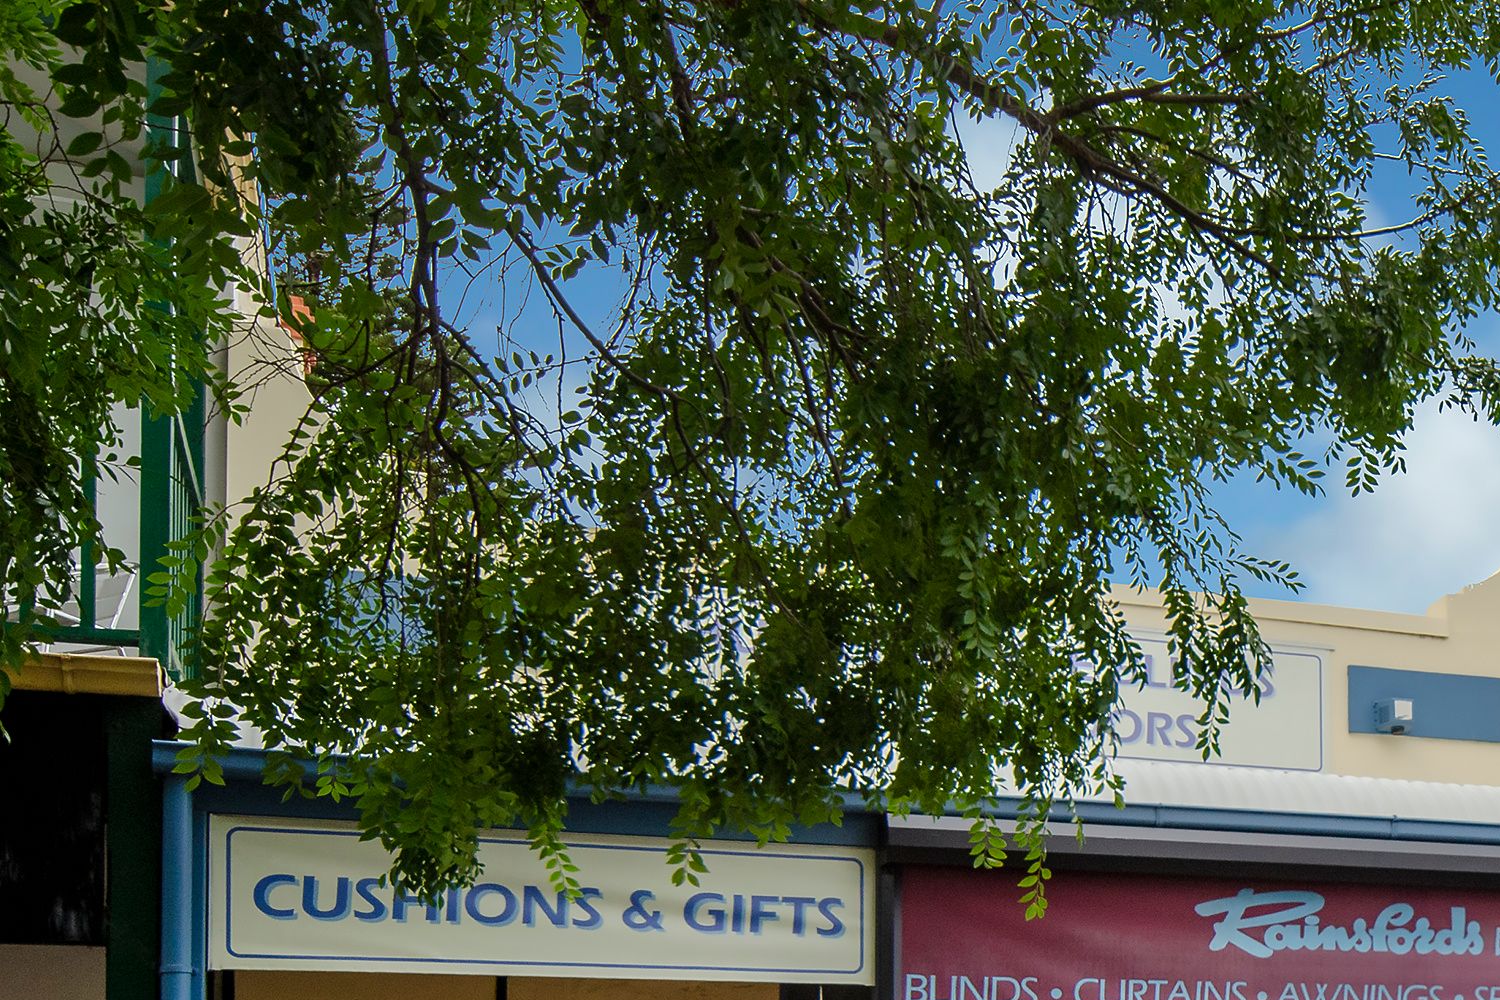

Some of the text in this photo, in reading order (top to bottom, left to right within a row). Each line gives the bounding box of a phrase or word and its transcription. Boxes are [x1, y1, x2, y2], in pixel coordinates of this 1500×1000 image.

[253, 873, 846, 938] CUSHIONS & GIFTS
[1194, 888, 1485, 958] Rainsfords
